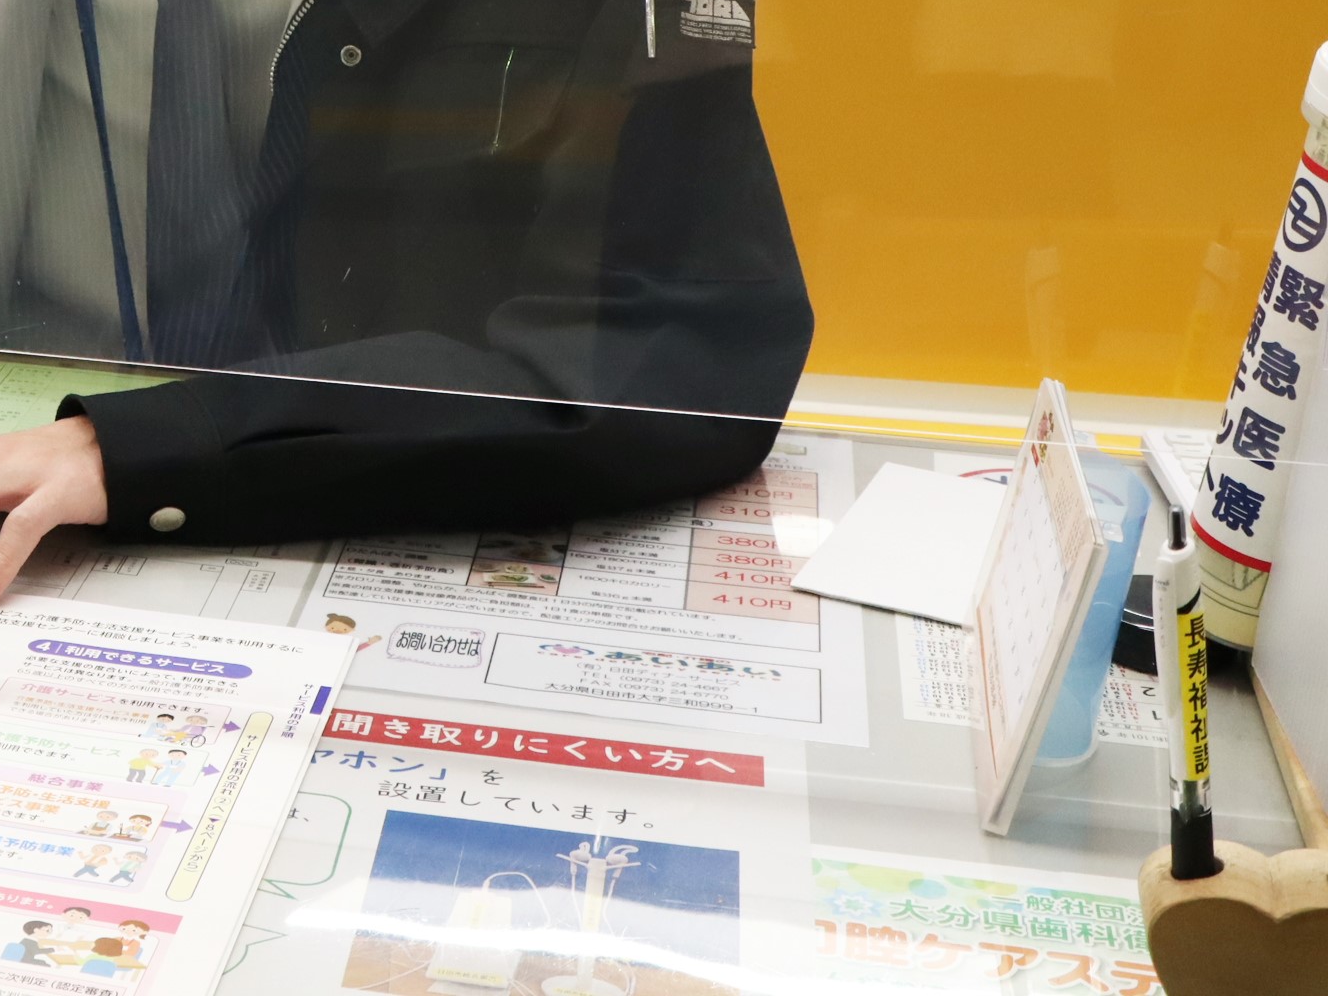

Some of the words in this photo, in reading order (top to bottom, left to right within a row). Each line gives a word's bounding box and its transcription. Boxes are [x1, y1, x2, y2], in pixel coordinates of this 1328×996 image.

[1211, 264, 1326, 538] 緊急医療
[714, 570, 791, 587] 410円
[712, 594, 791, 611] 410円
[395, 629, 481, 656] お問い合わせは
[64, 645, 226, 675] 利用できるサービス
[330, 710, 737, 775] 聞き取りにくい方へ
[27, 772, 105, 792] 総合事業
[377, 780, 656, 830] 設置しています。
